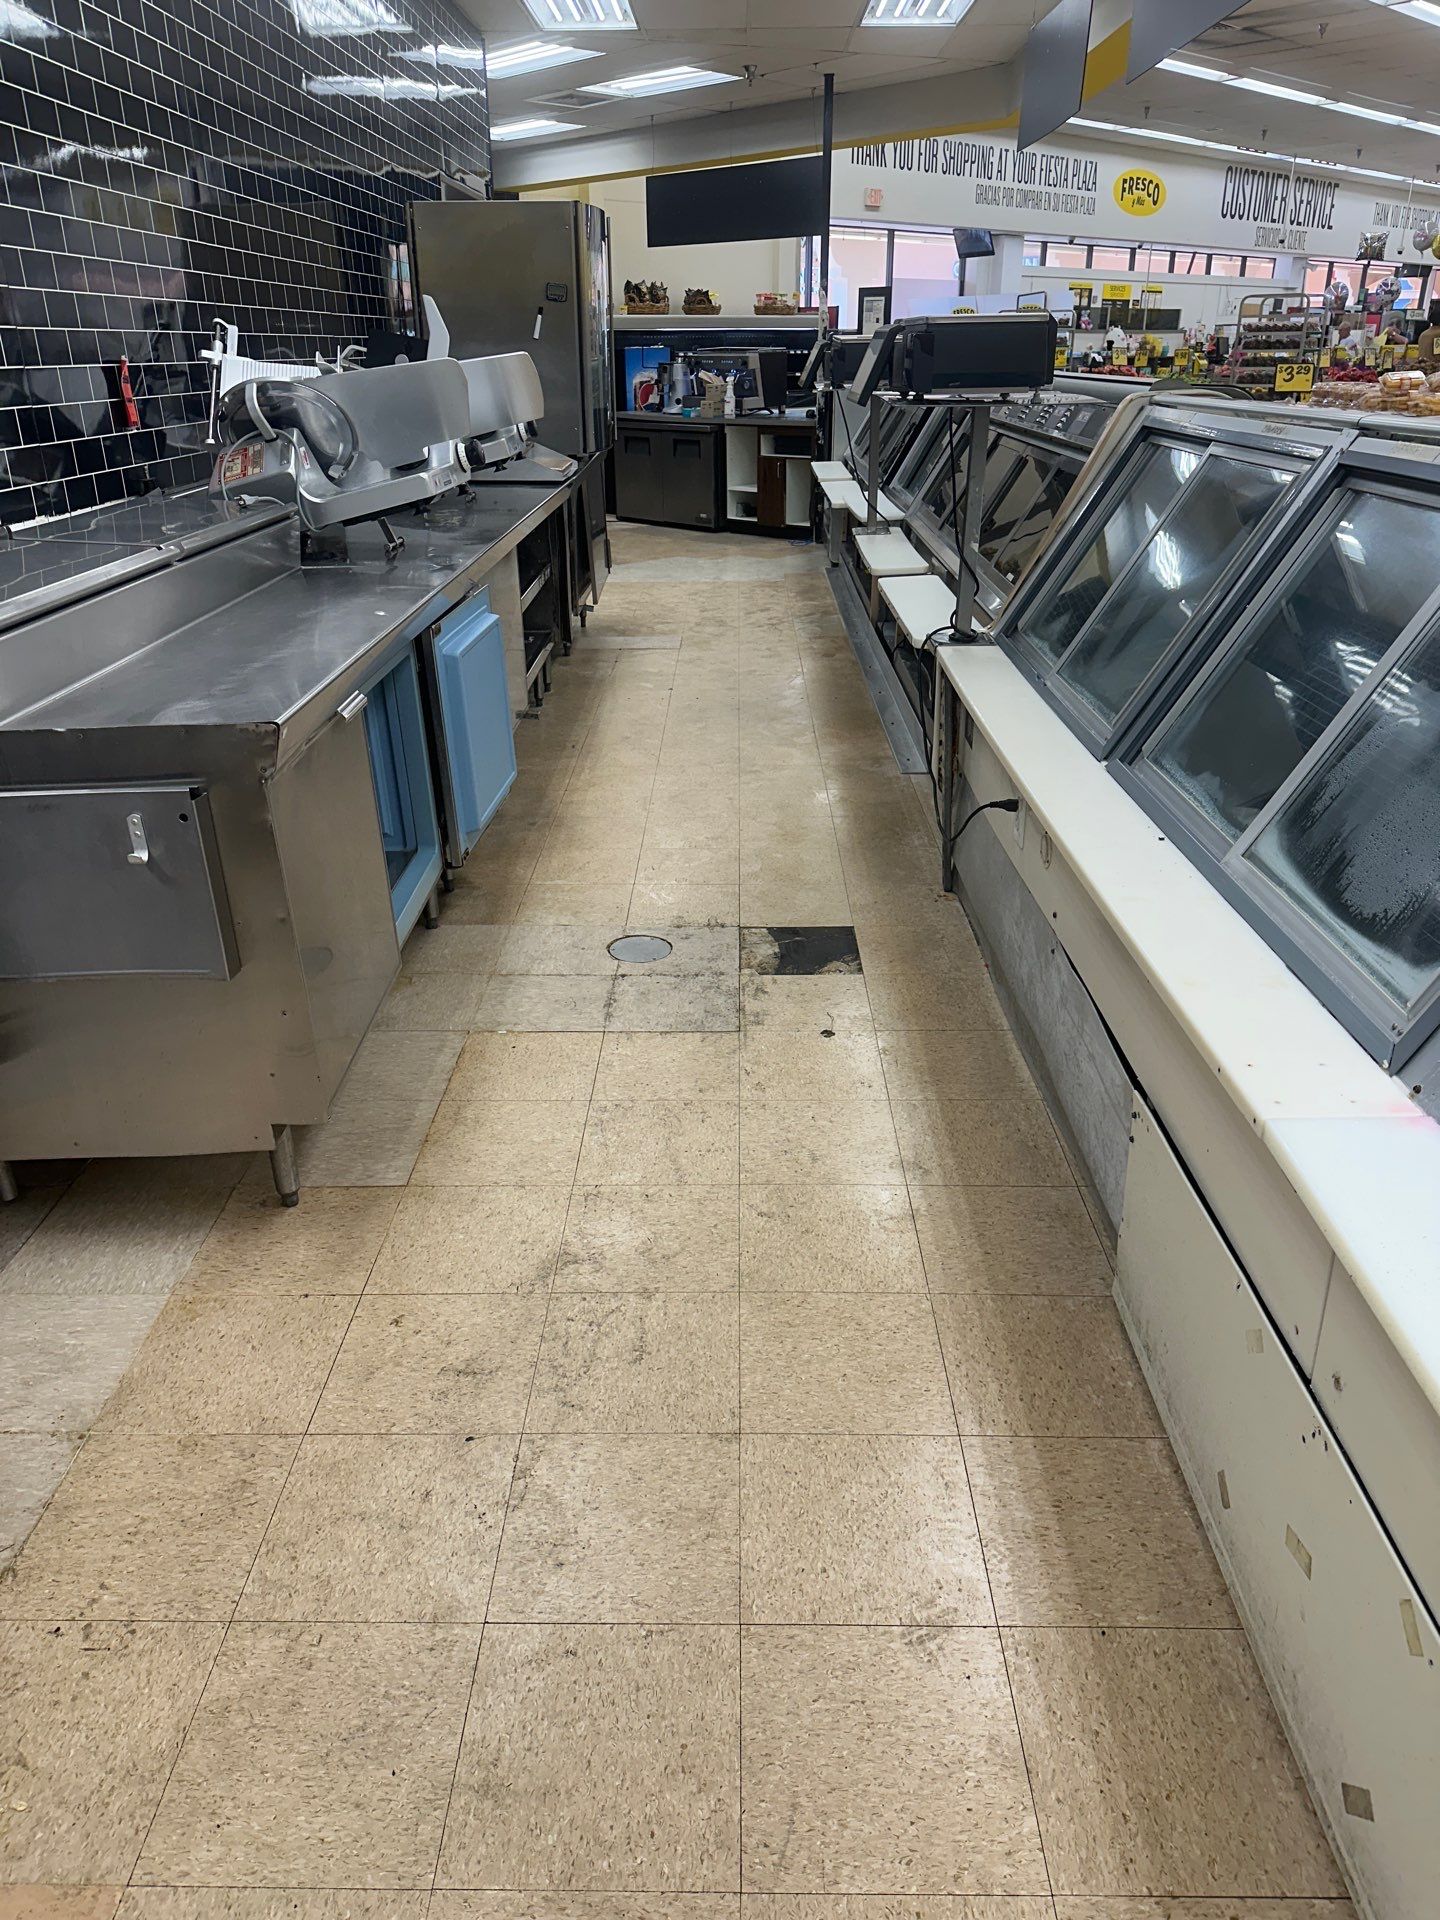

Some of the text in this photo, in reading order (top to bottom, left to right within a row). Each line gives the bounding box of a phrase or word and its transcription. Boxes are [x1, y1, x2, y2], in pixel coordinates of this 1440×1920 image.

[893, 140, 914, 171] YOU
[918, 138, 938, 173] FOR
[942, 139, 994, 180] SHOPPING
[996, 148, 1009, 182] AT
[1012, 149, 1037, 185] YOUR
[1038, 154, 1069, 189] FIESTA
[1071, 158, 1098, 192] PLAZA
[975, 184, 1096, 216] GRACIAS POR COMPRAR EN SU FIESTA PLAZA
[1120, 176, 1160, 206] FRESCO
[1221, 165, 1340, 230] CUSTOMER SERVICE
[1373, 202, 1391, 227] THANK
[1390, 204, 1402, 228] YOU
